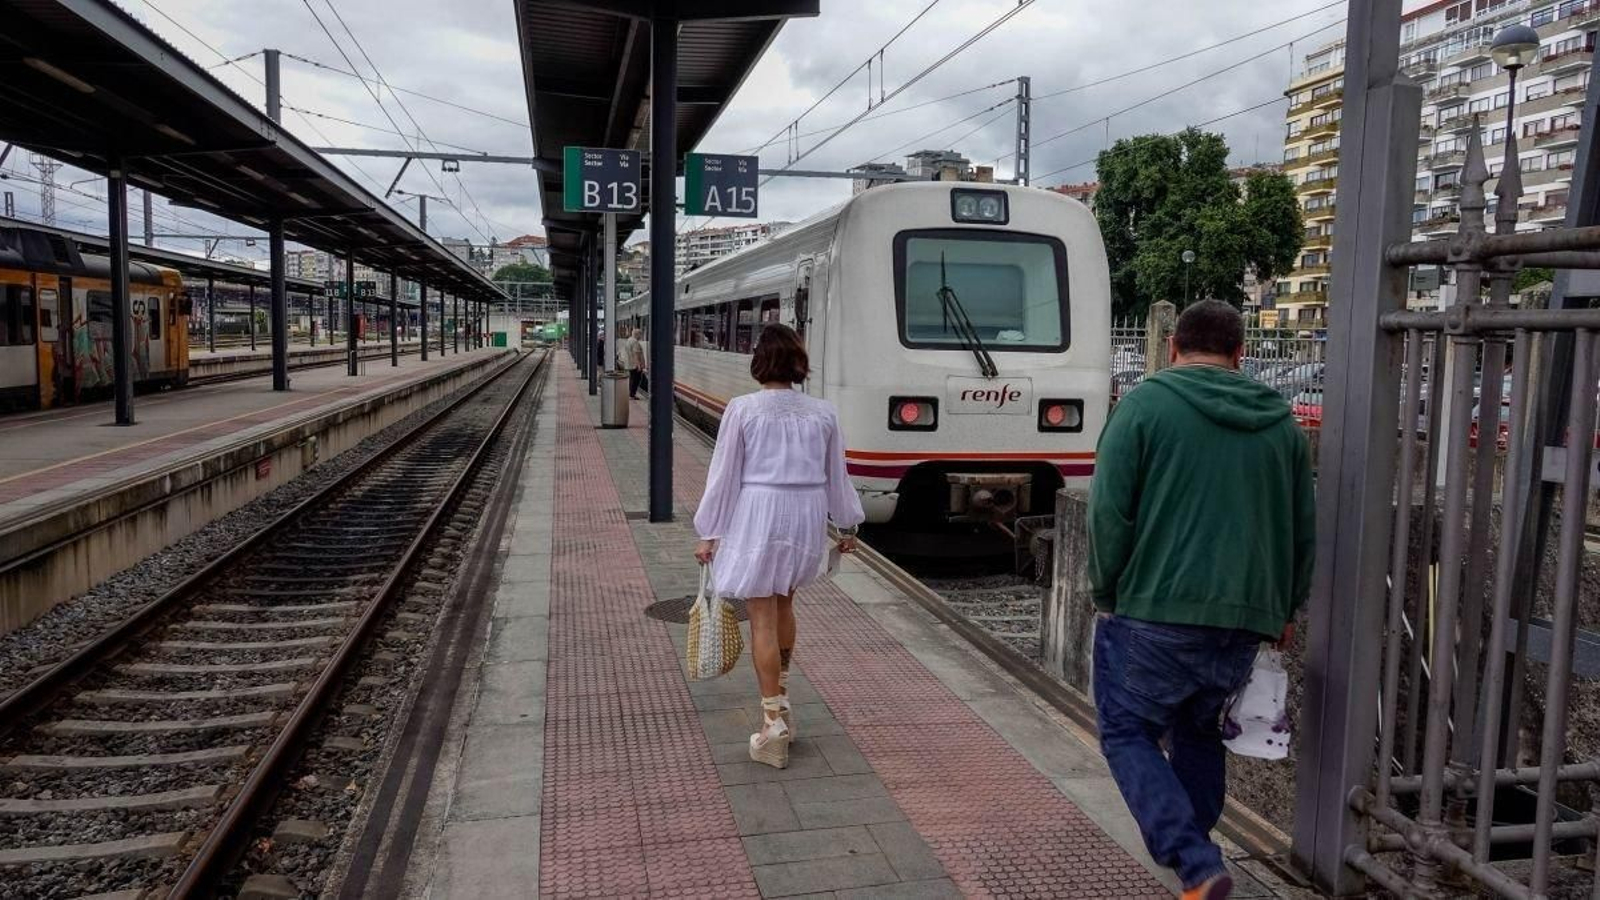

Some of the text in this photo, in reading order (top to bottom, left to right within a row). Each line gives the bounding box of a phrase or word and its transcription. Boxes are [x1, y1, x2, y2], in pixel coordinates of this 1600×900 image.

[584, 180, 638, 209] B 13
[704, 185, 756, 214] A 15
[960, 383, 1022, 409] renfe
